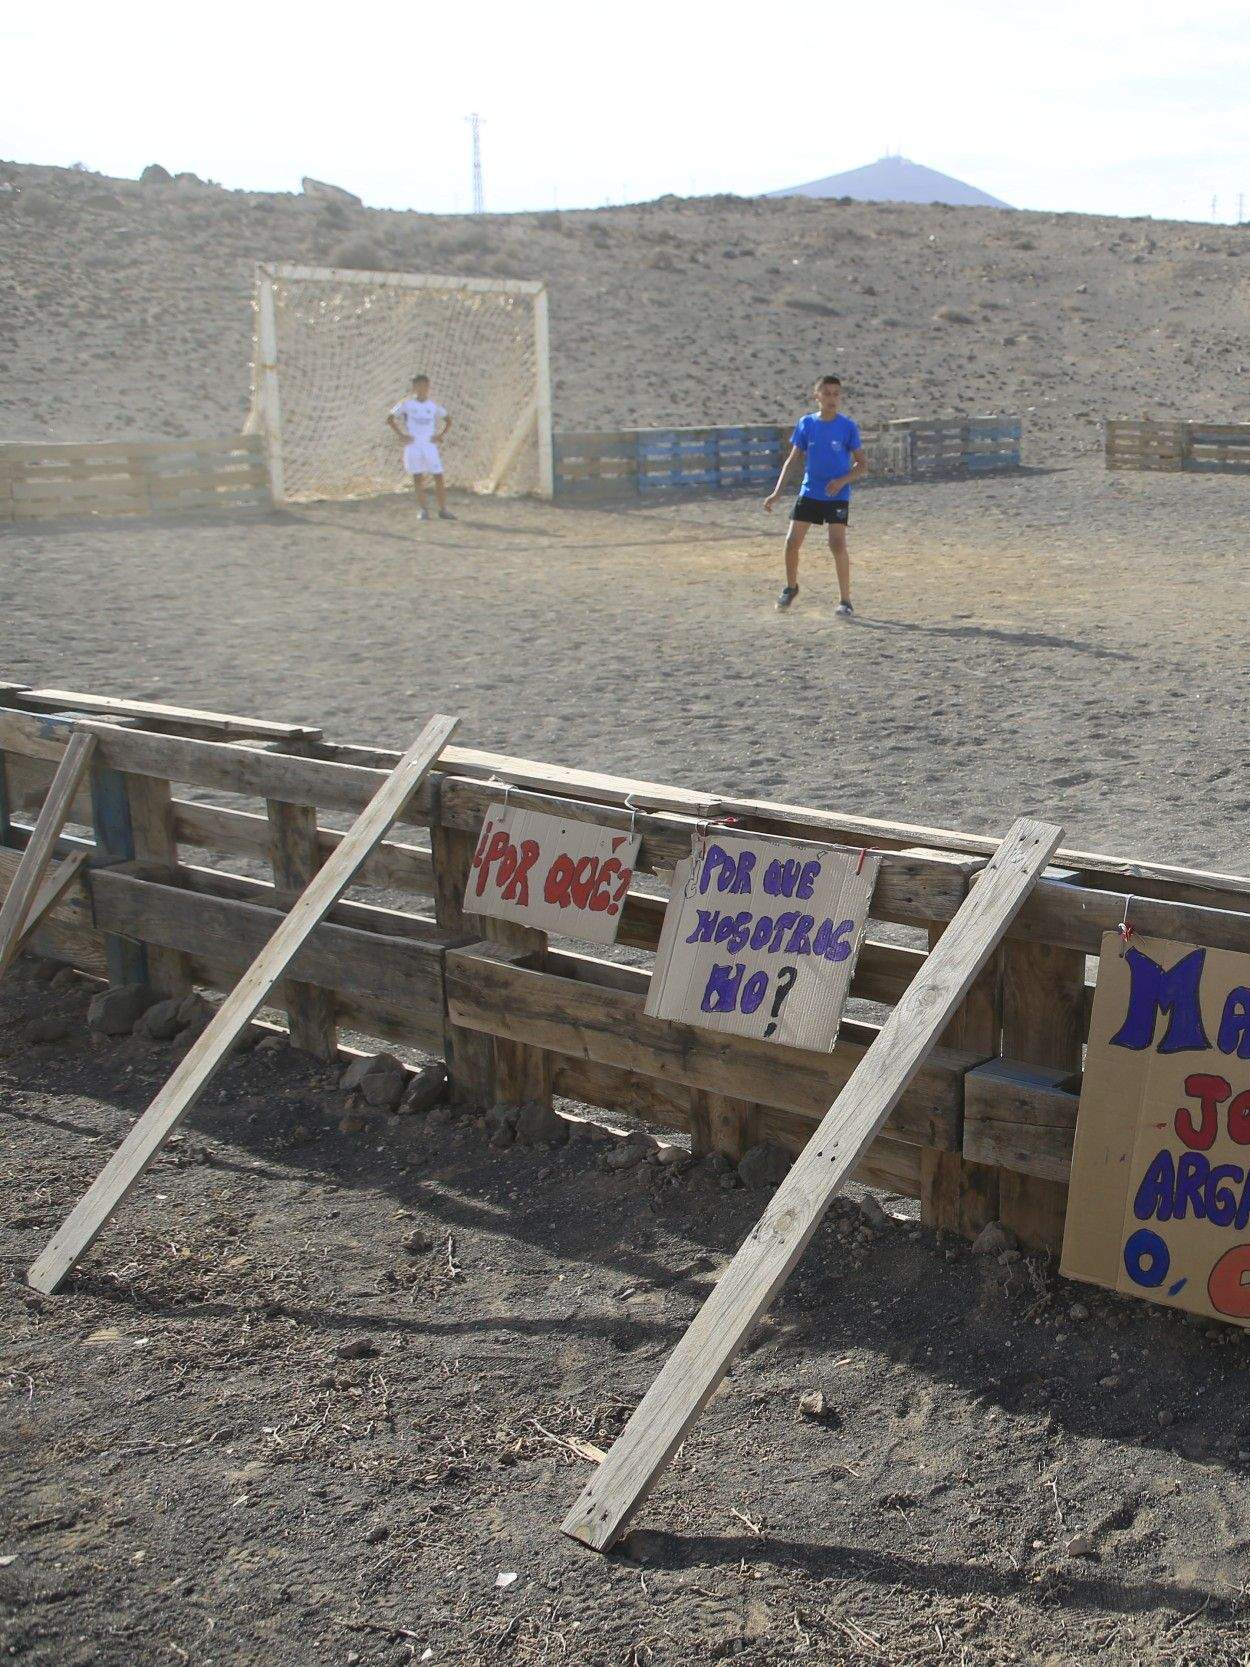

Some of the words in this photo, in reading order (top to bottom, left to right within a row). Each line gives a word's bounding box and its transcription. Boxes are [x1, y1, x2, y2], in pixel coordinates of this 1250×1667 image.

[544, 836, 633, 916] QUÉ?
[686, 909, 855, 962] NOSOTROS
[701, 964, 797, 1038] NO?
